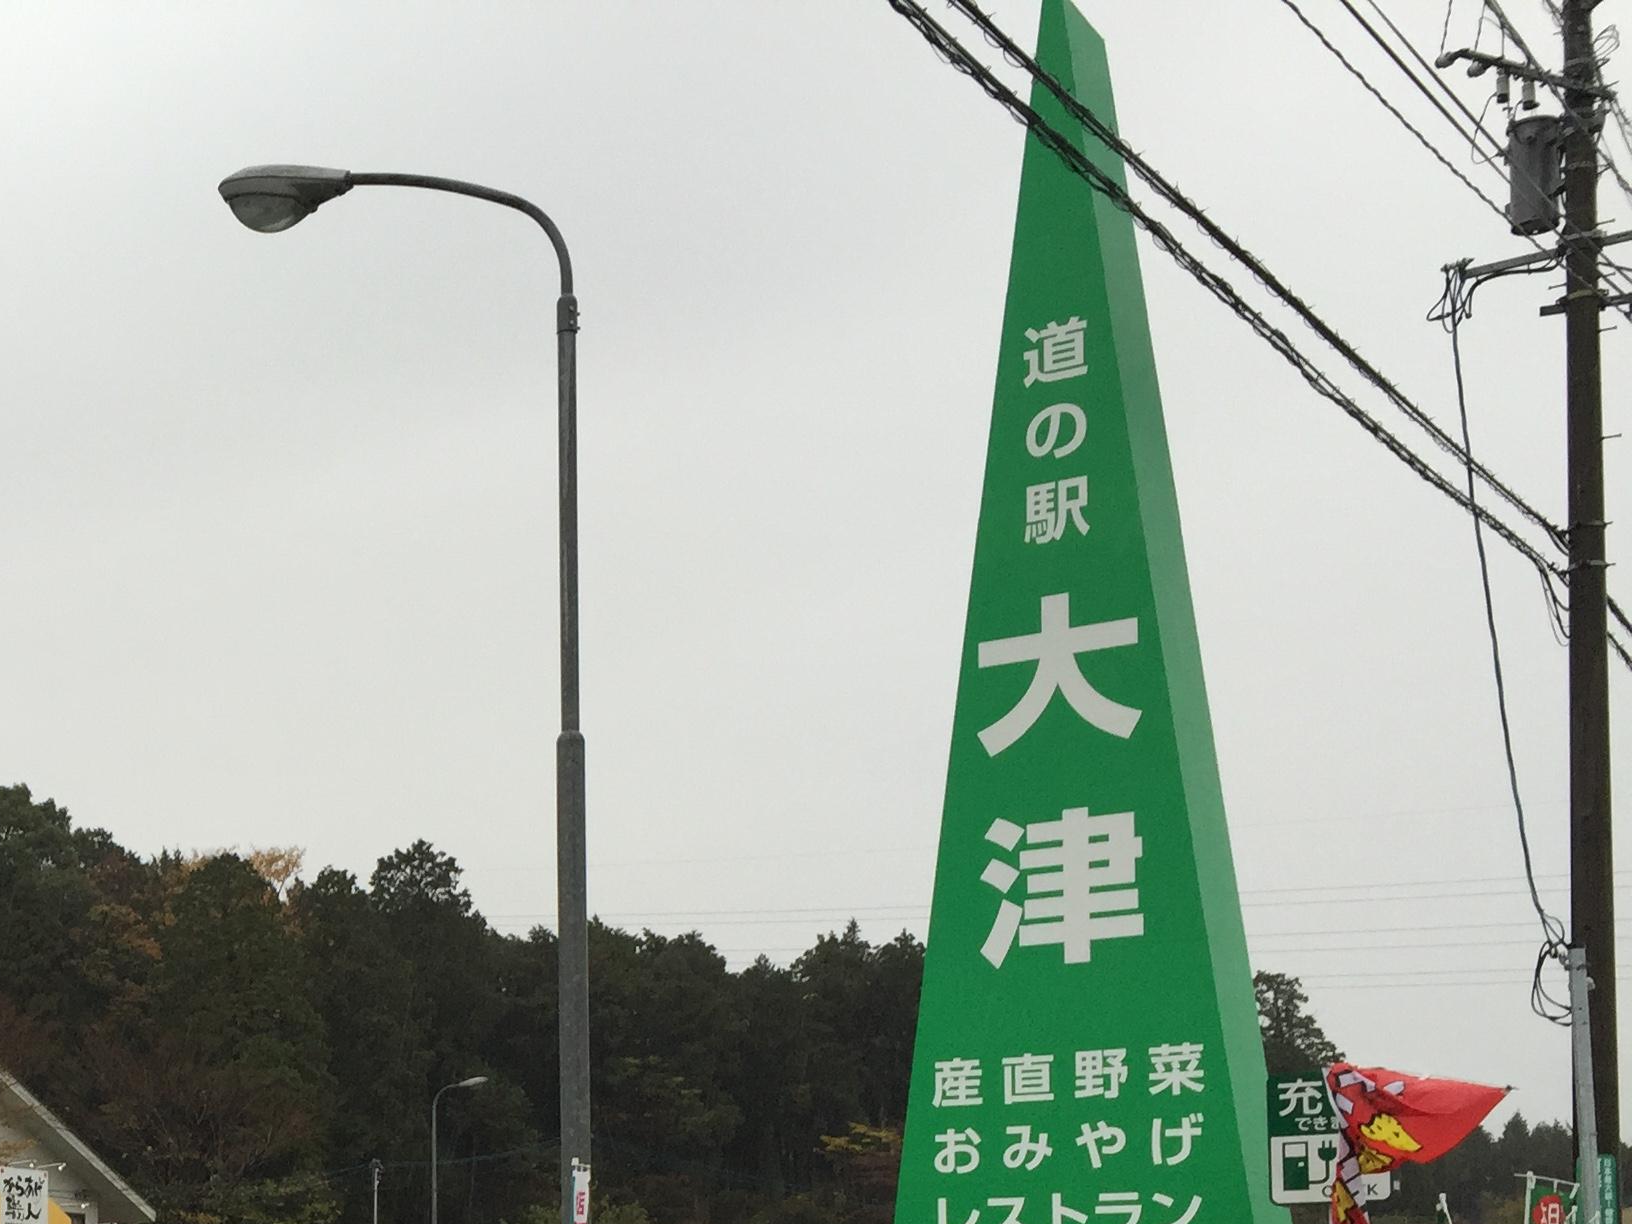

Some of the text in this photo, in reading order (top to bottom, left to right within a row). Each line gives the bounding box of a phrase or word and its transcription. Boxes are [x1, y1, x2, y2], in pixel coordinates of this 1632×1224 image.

[977, 314, 1144, 969] 道の駅 大津
[932, 1042, 1206, 1109] 産直野菜
[1277, 1077, 1323, 1117] 充
[932, 1113, 1203, 1177] おみやげ
[1294, 1116, 1341, 1132] できま
